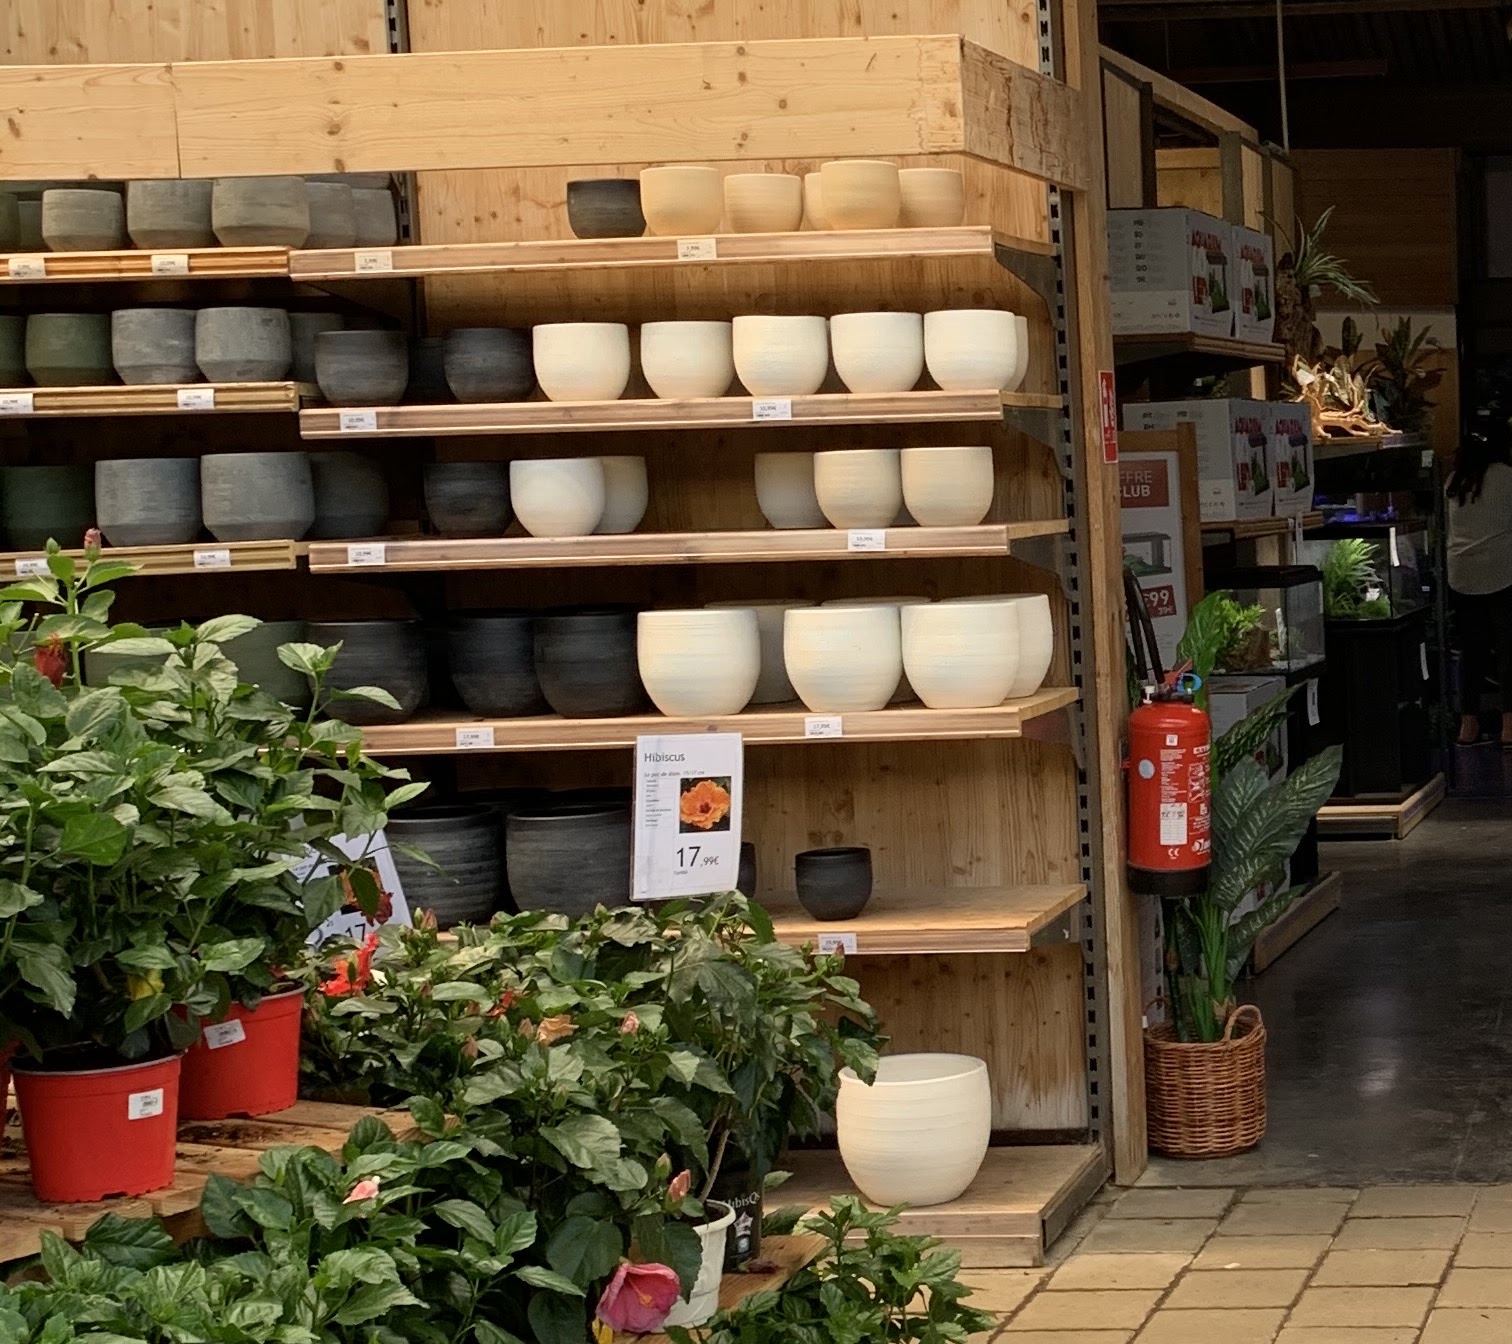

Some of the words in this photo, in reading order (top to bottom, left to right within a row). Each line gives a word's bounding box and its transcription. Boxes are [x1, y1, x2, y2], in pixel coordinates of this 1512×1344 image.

[1120, 471, 1152, 484] FFRE
[1120, 485, 1151, 498] LUB
[644, 752, 686, 763] Hibiscus
